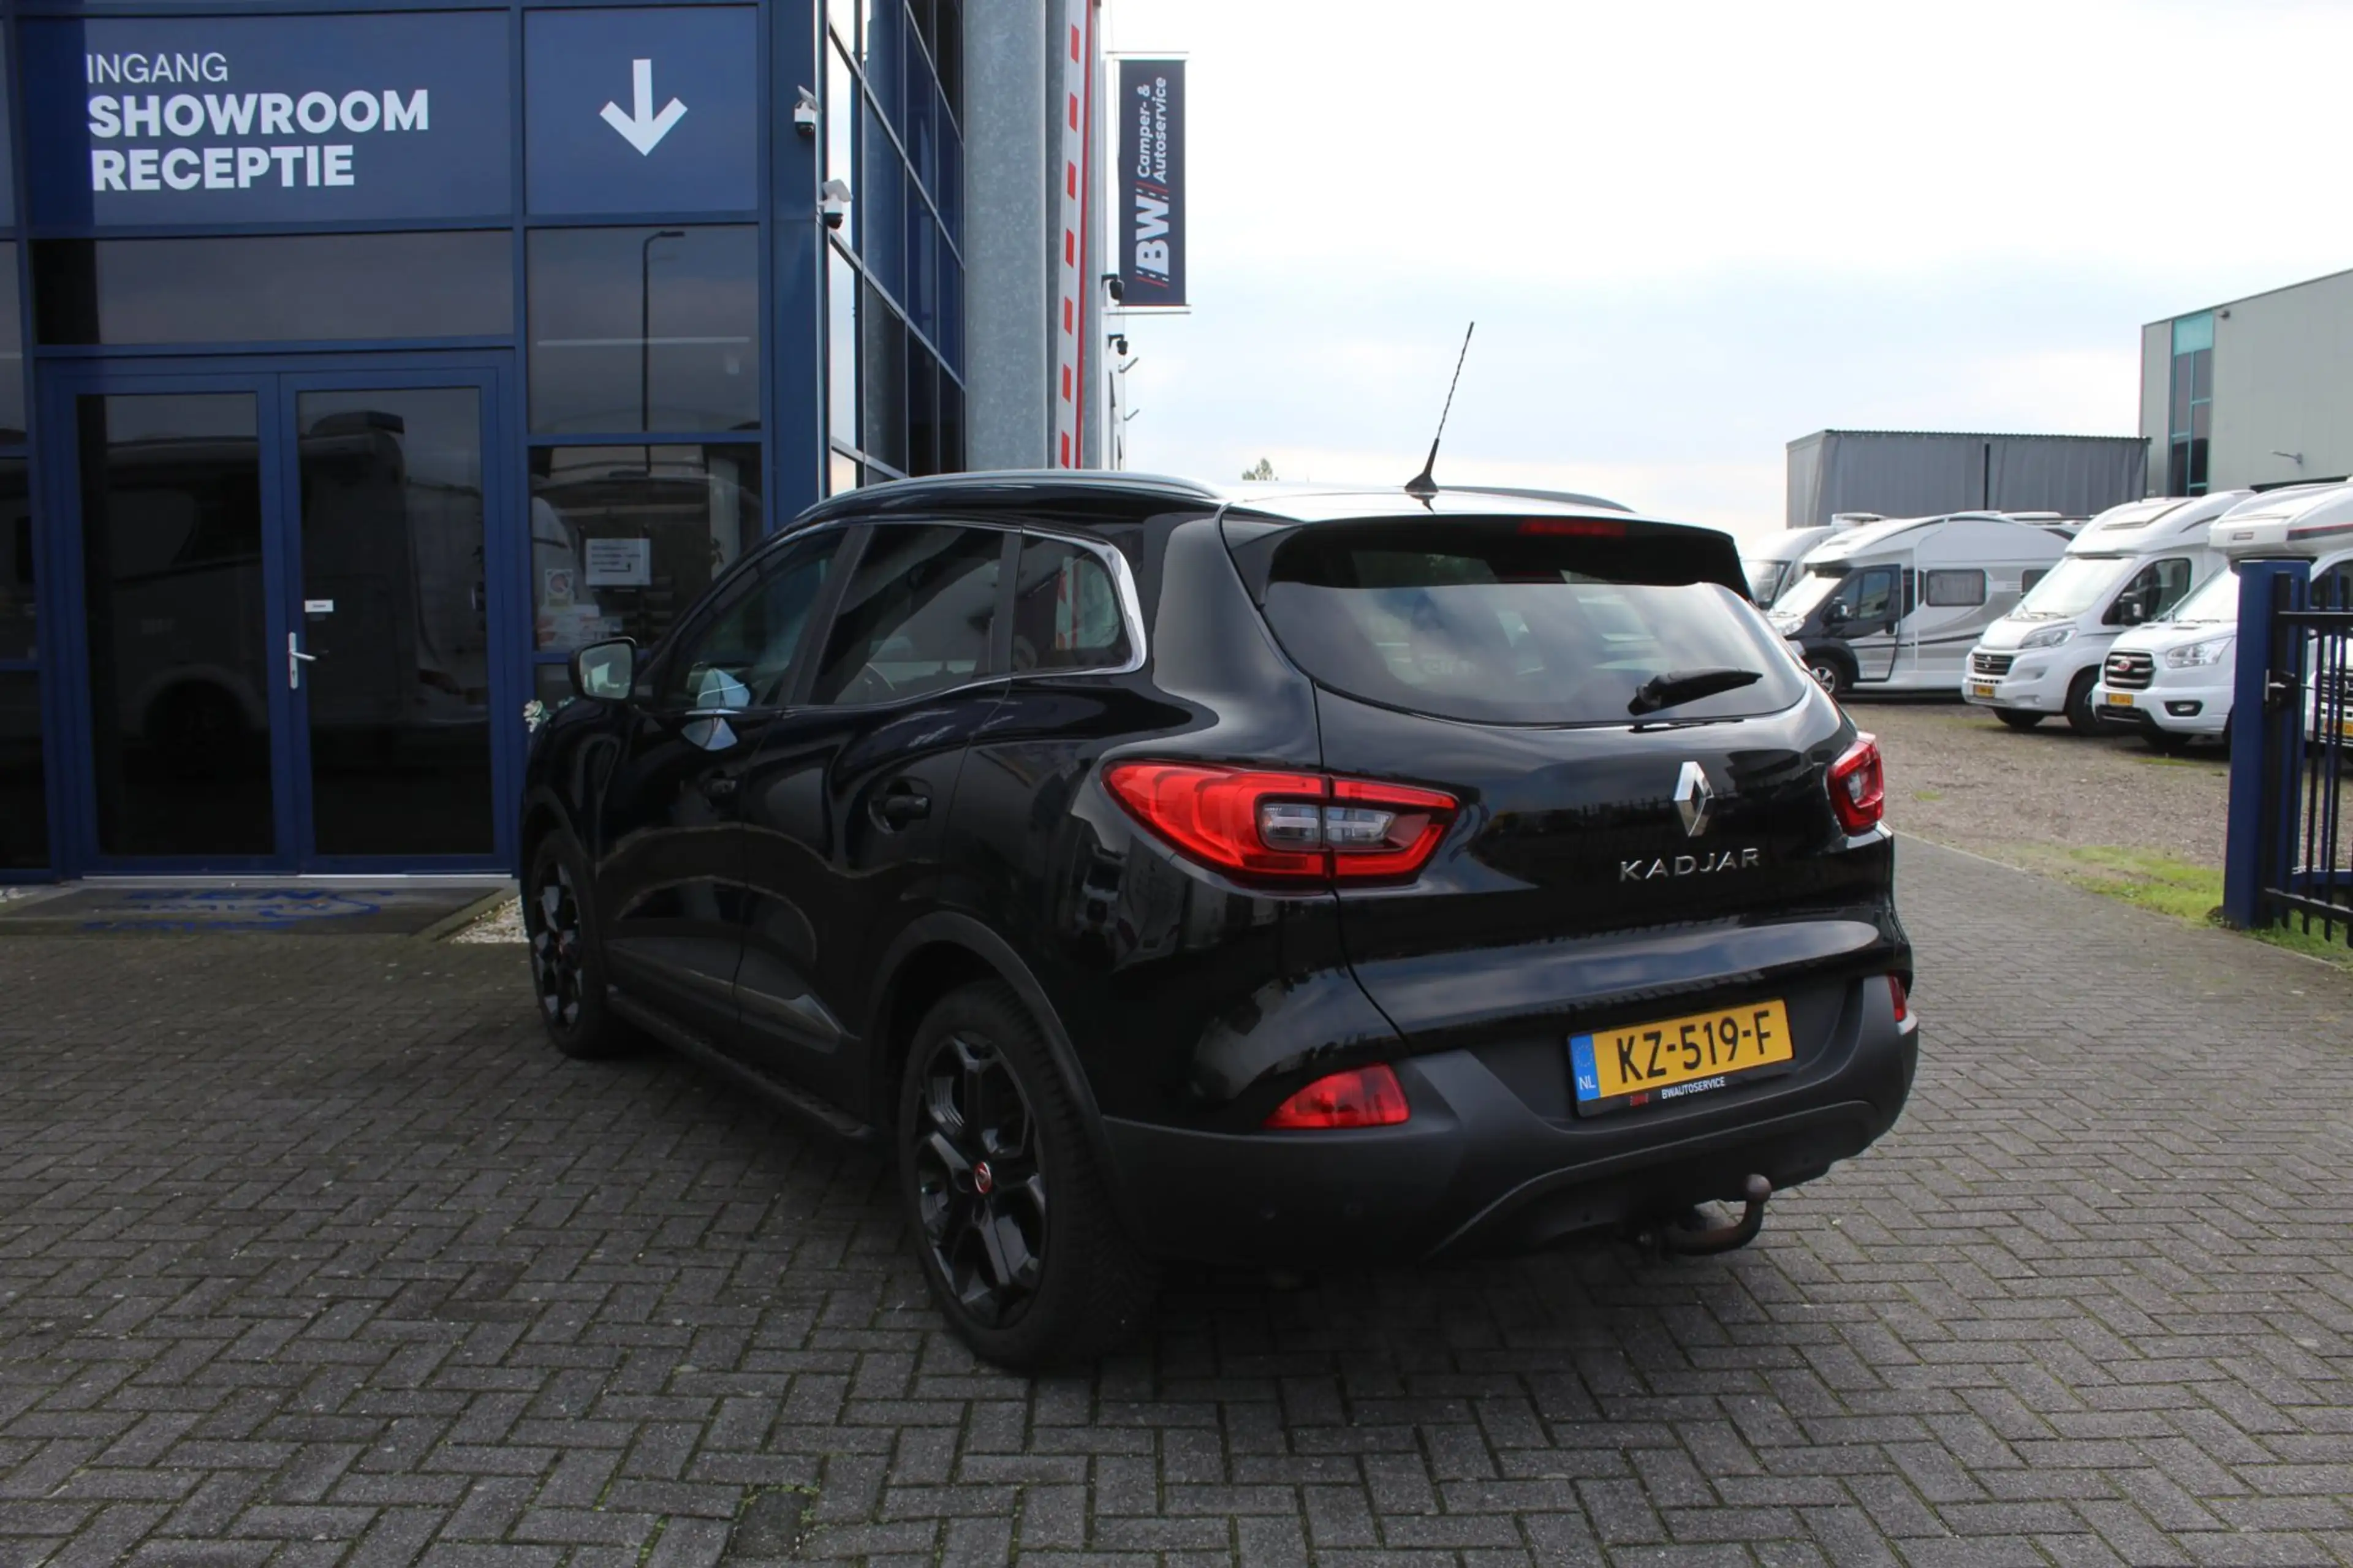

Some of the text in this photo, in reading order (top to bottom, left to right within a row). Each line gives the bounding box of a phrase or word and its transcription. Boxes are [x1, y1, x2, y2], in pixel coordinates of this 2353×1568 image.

[86, 53, 228, 83] INGANG
[88, 89, 429, 138] SHOWROOM
[1137, 85, 1154, 178] Camper- &
[1152, 77, 1167, 183] Autoservice
[91, 145, 355, 191] RECEPTIE
[1135, 194, 1169, 275] BW
[1619, 848, 1760, 882] KADJAR
[1616, 1010, 1771, 1084] KZ-519-F
[1578, 1075, 1596, 1090] NL
[1661, 1076, 1726, 1099] BWAUTOSERVICE
